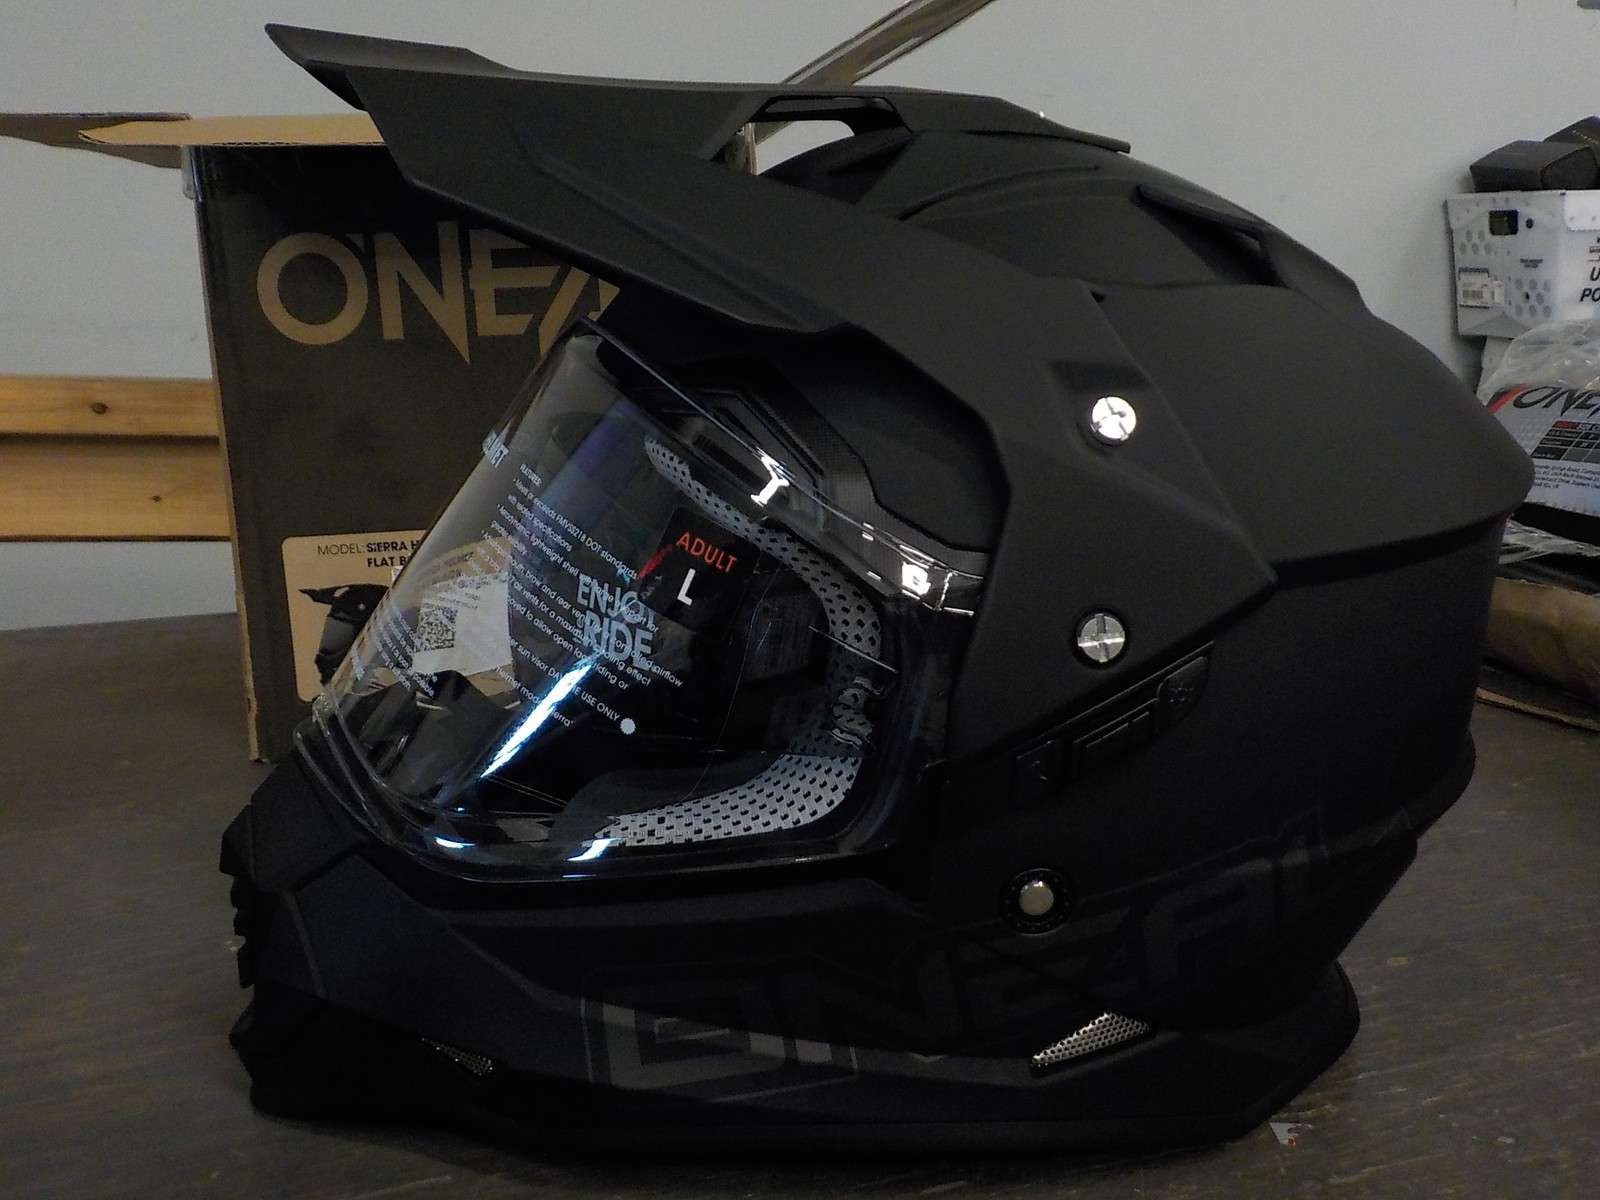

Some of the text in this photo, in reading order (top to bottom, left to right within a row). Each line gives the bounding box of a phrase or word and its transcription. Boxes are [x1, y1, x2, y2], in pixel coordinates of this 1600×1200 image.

[317, 543, 365, 556] MODEL:
[366, 541, 408, 553] SIERRA
[367, 556, 394, 568] FLAT
[556, 514, 587, 543] FMVSS218
[586, 537, 602, 553] DOT
[601, 549, 638, 580] standards
[562, 560, 580, 577] shell
[675, 530, 738, 574] ADULT
[676, 567, 696, 606] L
[522, 588, 540, 606] vents
[539, 601, 550, 614] for
[625, 666, 652, 688] effect
[525, 569, 543, 588] brow
[541, 584, 557, 599] and
[556, 596, 573, 612] rear
[653, 665, 684, 688] airflow
[525, 611, 534, 621] to
[533, 618, 554, 636] allow
[552, 633, 574, 652] open
[617, 681, 630, 691] or
[583, 609, 655, 671] RIDE
[517, 644, 532, 658] sun
[531, 654, 550, 673] visor
[580, 689, 597, 706] USE
[596, 702, 621, 722] ONLY
